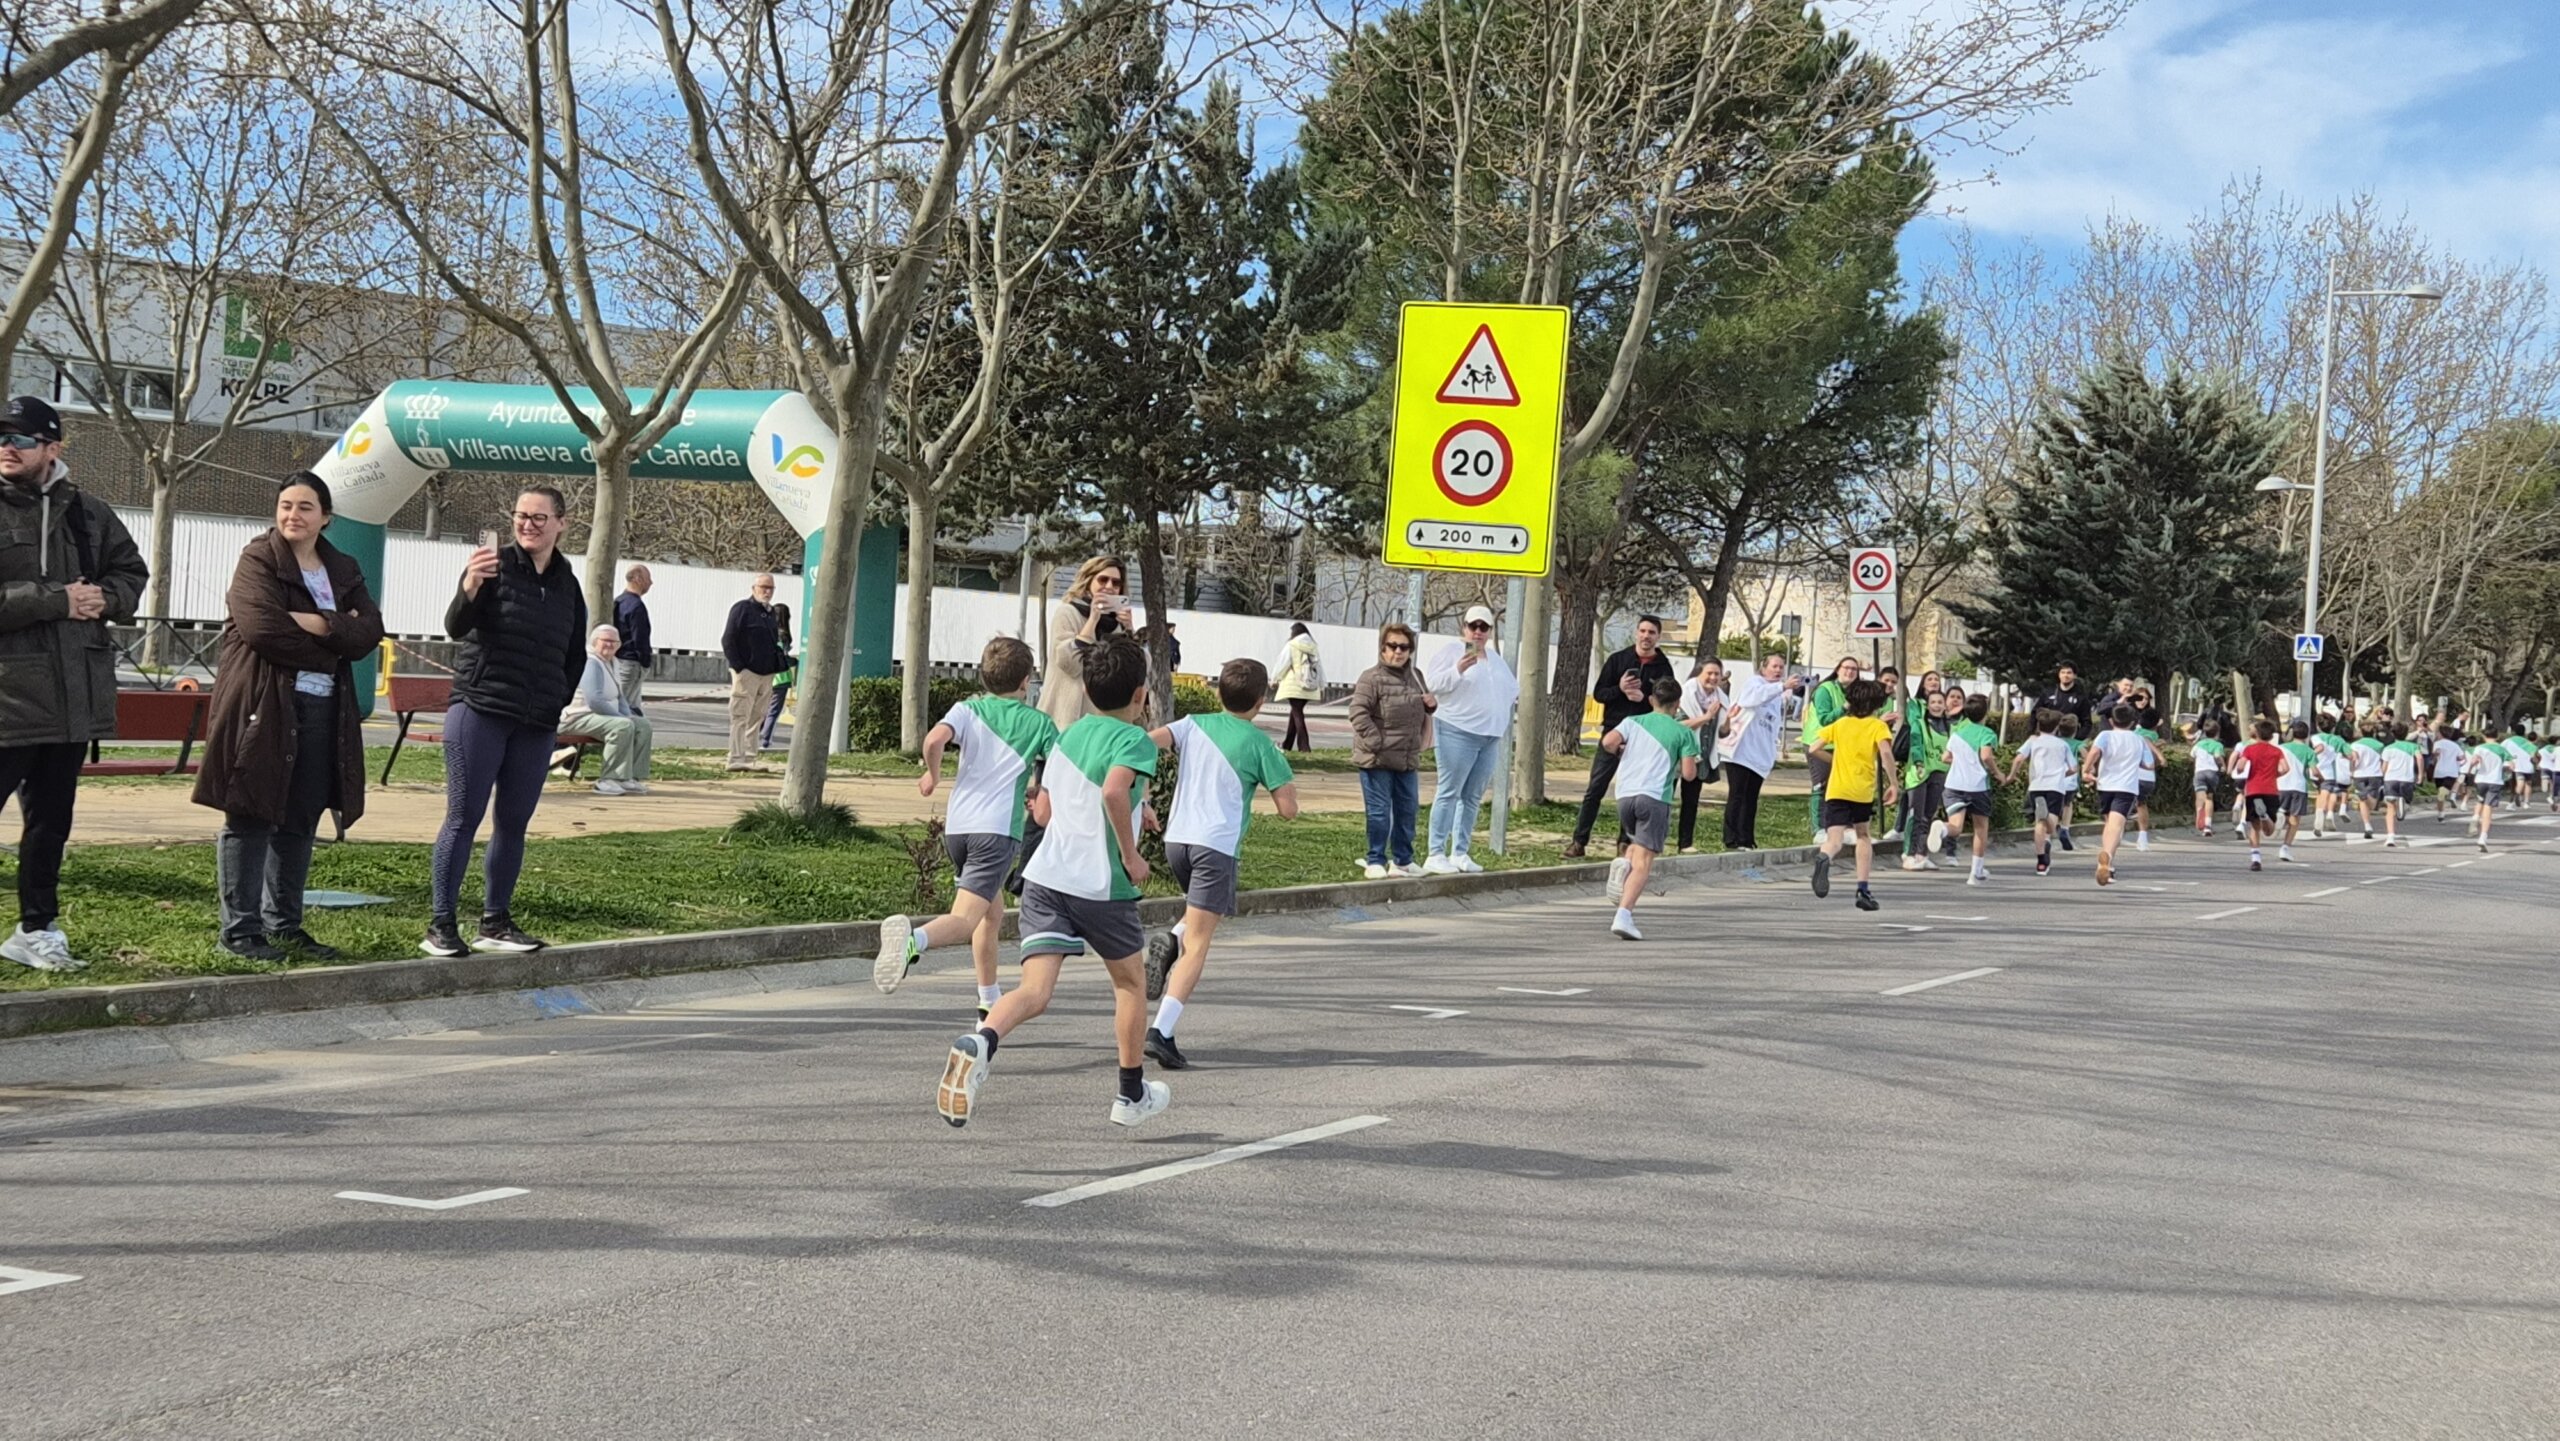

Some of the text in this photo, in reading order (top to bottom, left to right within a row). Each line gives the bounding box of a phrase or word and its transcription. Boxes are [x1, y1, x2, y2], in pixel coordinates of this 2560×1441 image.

[221, 377, 290, 404] KBE
[447, 438, 574, 463] Villanueva
[646, 442, 741, 467] Cañada
[1450, 448, 1495, 477] 20
[1440, 528, 1495, 545] 200 m
[1860, 564, 1884, 579] 20
